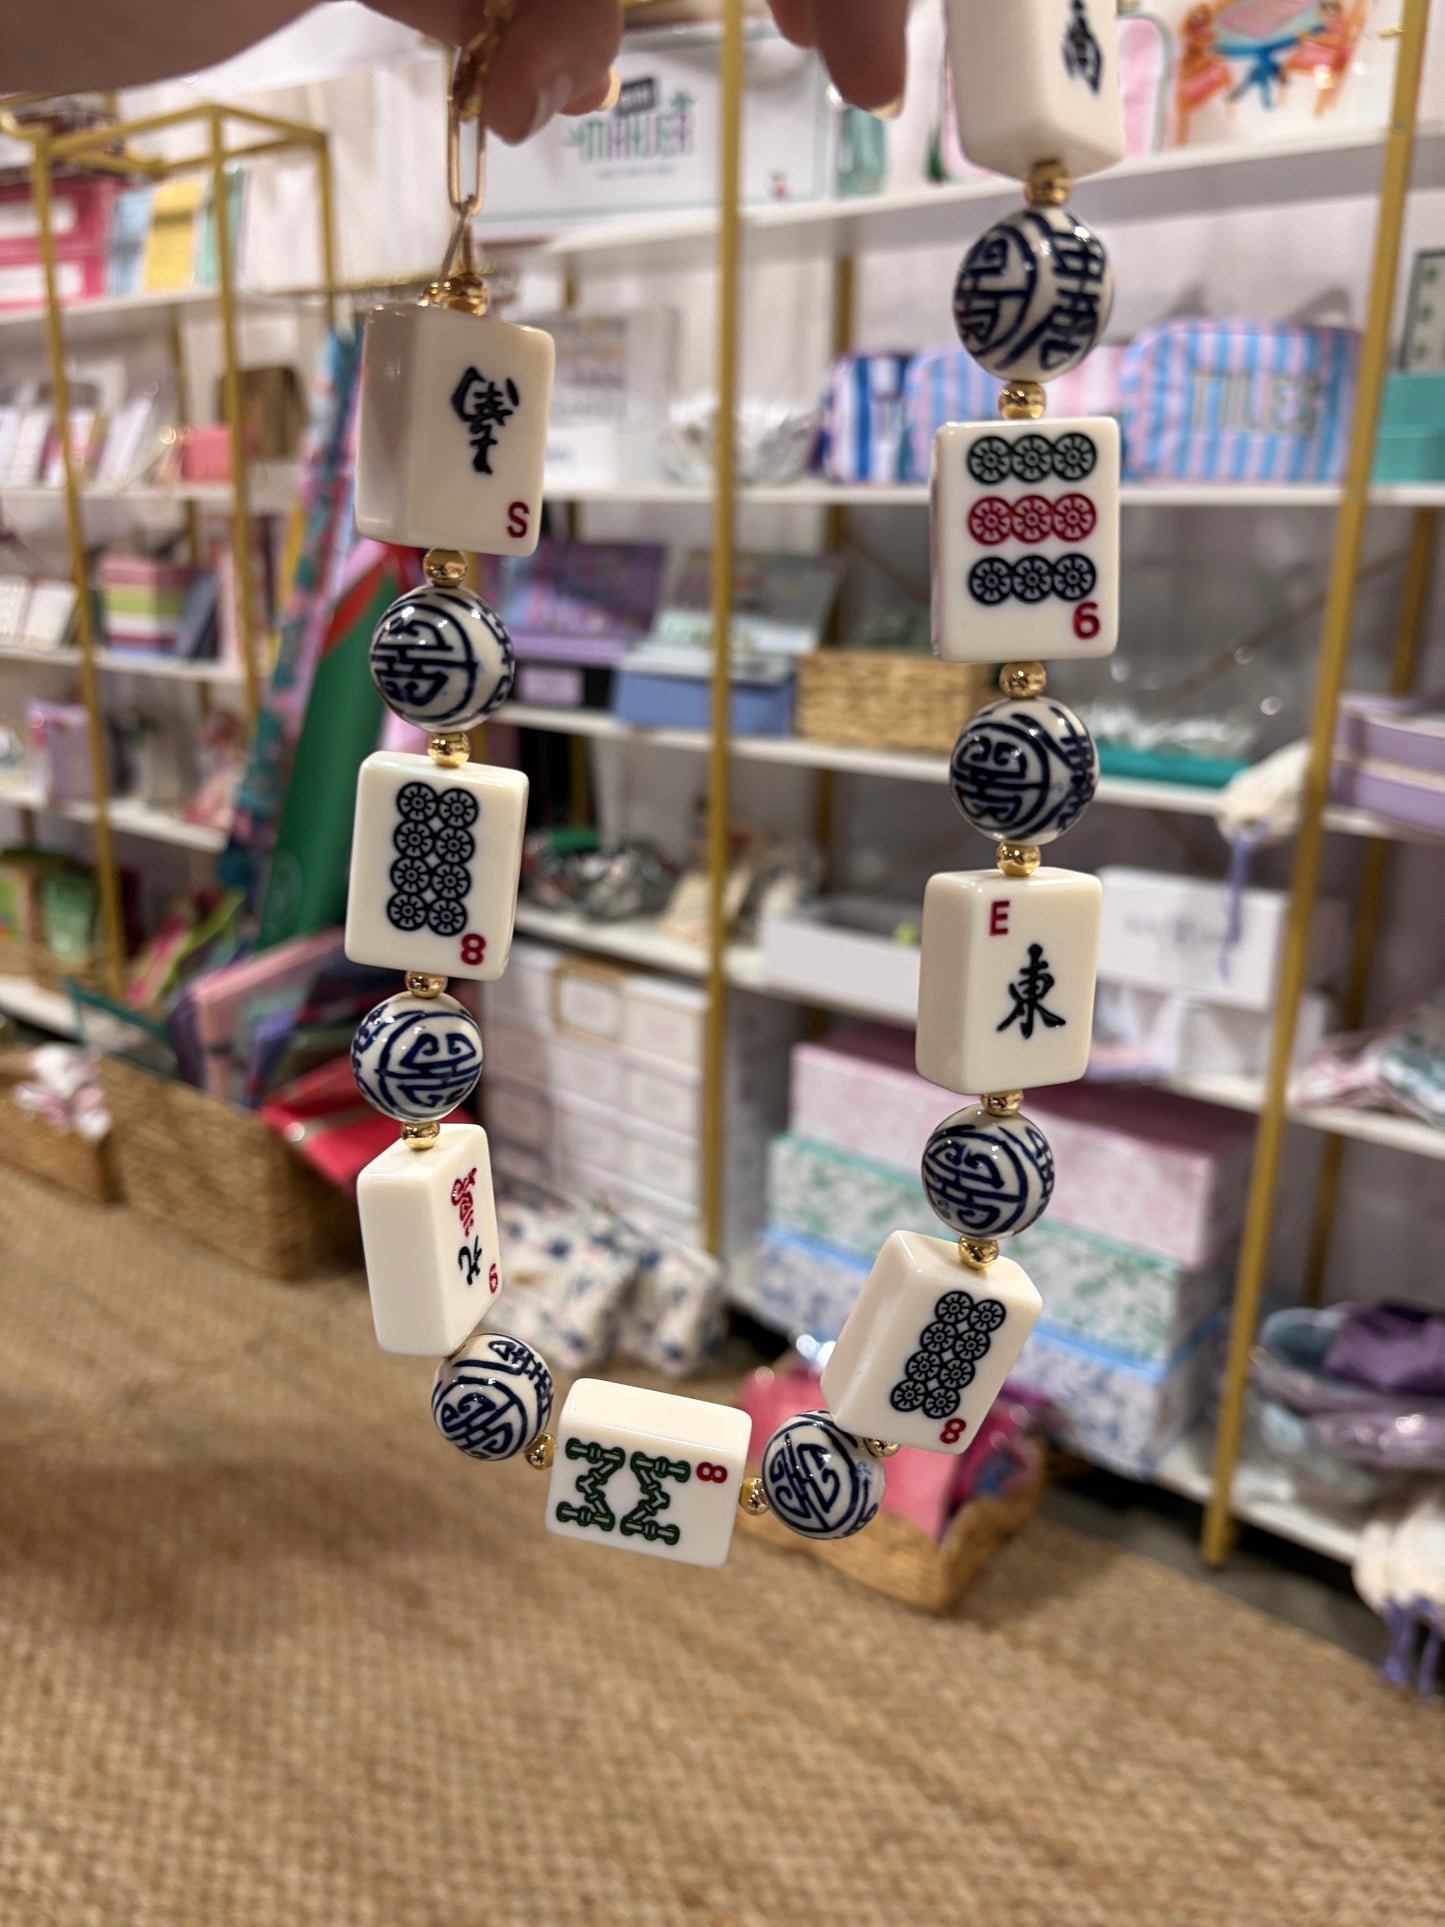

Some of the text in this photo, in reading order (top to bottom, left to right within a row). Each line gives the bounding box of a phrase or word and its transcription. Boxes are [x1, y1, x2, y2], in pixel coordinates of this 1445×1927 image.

[507, 501, 529, 538] S
[988, 900, 1011, 937] E
[460, 933, 487, 966] 8
[996, 943, 1067, 1039] 東
[939, 1418, 966, 1445] 8
[696, 1461, 728, 1484] 8
